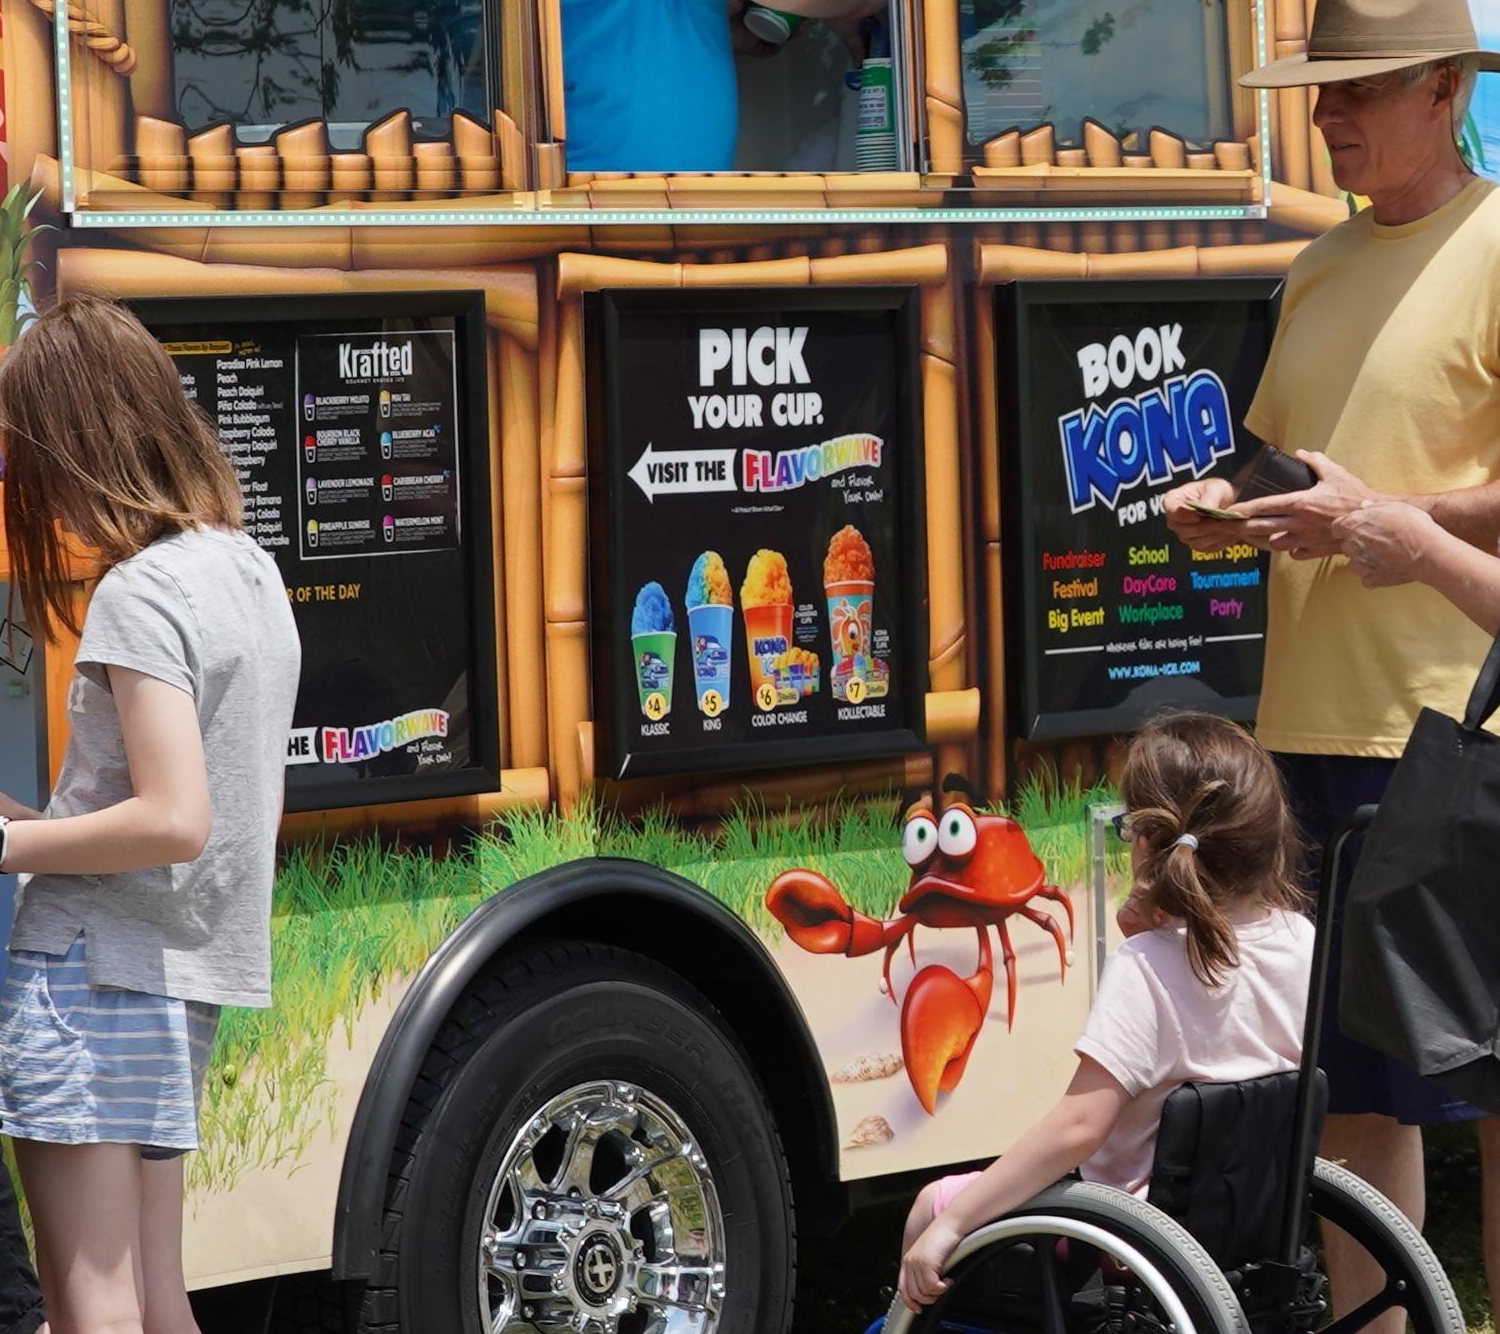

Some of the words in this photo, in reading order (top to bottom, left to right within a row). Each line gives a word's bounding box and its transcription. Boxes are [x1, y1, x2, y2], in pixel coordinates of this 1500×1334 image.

[216, 359, 245, 370] Paradise
[246, 357, 260, 369] Pink
[260, 358, 283, 369] Lemon
[338, 340, 413, 378] Krafted
[698, 325, 812, 388] PICK
[1077, 323, 1186, 399] BOOK
[217, 372, 238, 384] Peach
[217, 387, 238, 398] Peach
[239, 385, 264, 398] Daiquiri
[234, 400, 257, 410] Colada
[316, 396, 349, 405] BLACKBERRY
[350, 395, 370, 404] MOJITO
[687, 393, 764, 429] YOUR
[771, 392, 825, 427] CUP.
[218, 414, 232, 425] Pink
[233, 414, 270, 425] Bubblegum
[219, 428, 251, 439] Raspberry
[251, 427, 275, 437] Colada
[316, 430, 343, 438] BOURBON
[343, 429, 360, 437] BLACK
[392, 430, 422, 439] BLUEBERRY
[251, 440, 277, 452] Daiquiri
[317, 437, 337, 446] CHERRY
[338, 437, 360, 445] VANILLA
[1060, 371, 1234, 513] KONA
[233, 455, 266, 467] Raspberry
[646, 462, 688, 484] VISIT
[694, 460, 727, 482] THE
[744, 434, 882, 491] FLAVORWAVE
[252, 481, 268, 491] Float
[318, 479, 345, 489] LAVENDER
[346, 477, 374, 487] LEMONADE
[393, 476, 423, 486] CARIBBEAN
[424, 475, 444, 484] CHERRY
[830, 473, 846, 488] and
[256, 495, 282, 505] Banana
[257, 508, 280, 519] Colada
[395, 517, 430, 526] WATERMELON
[431, 516, 444, 525] MINT
[1116, 503, 1148, 527] FOR
[257, 521, 282, 534] Daiquiri
[319, 522, 348, 531] PINEAPPLE
[348, 520, 370, 529] SUNRISE
[257, 534, 290, 546] Shortcake
[1043, 549, 1107, 571] Fundraiser
[1128, 543, 1170, 566] School
[1123, 574, 1177, 597] DayCare
[1190, 568, 1261, 590] Tournament
[297, 587, 312, 602] OF
[314, 584, 336, 602] THE
[338, 583, 361, 600] DAY
[1053, 577, 1098, 600] Festival
[1118, 602, 1184, 626] Workplace
[1210, 598, 1243, 620] Party
[1048, 609, 1068, 633] Big
[1071, 606, 1105, 627] Event
[760, 688, 772, 706] $6
[848, 681, 861, 699] $7
[648, 697, 661, 714] $4
[704, 694, 717, 713] $5
[751, 713, 776, 727] COLOR
[777, 710, 808, 725] CHANGE
[837, 704, 886, 721] KOLLECTABLE
[640, 722, 671, 736] KLASSIC
[703, 718, 722, 732] KING
[288, 736, 310, 757] HE
[323, 710, 448, 762] FLAVORWAVE
